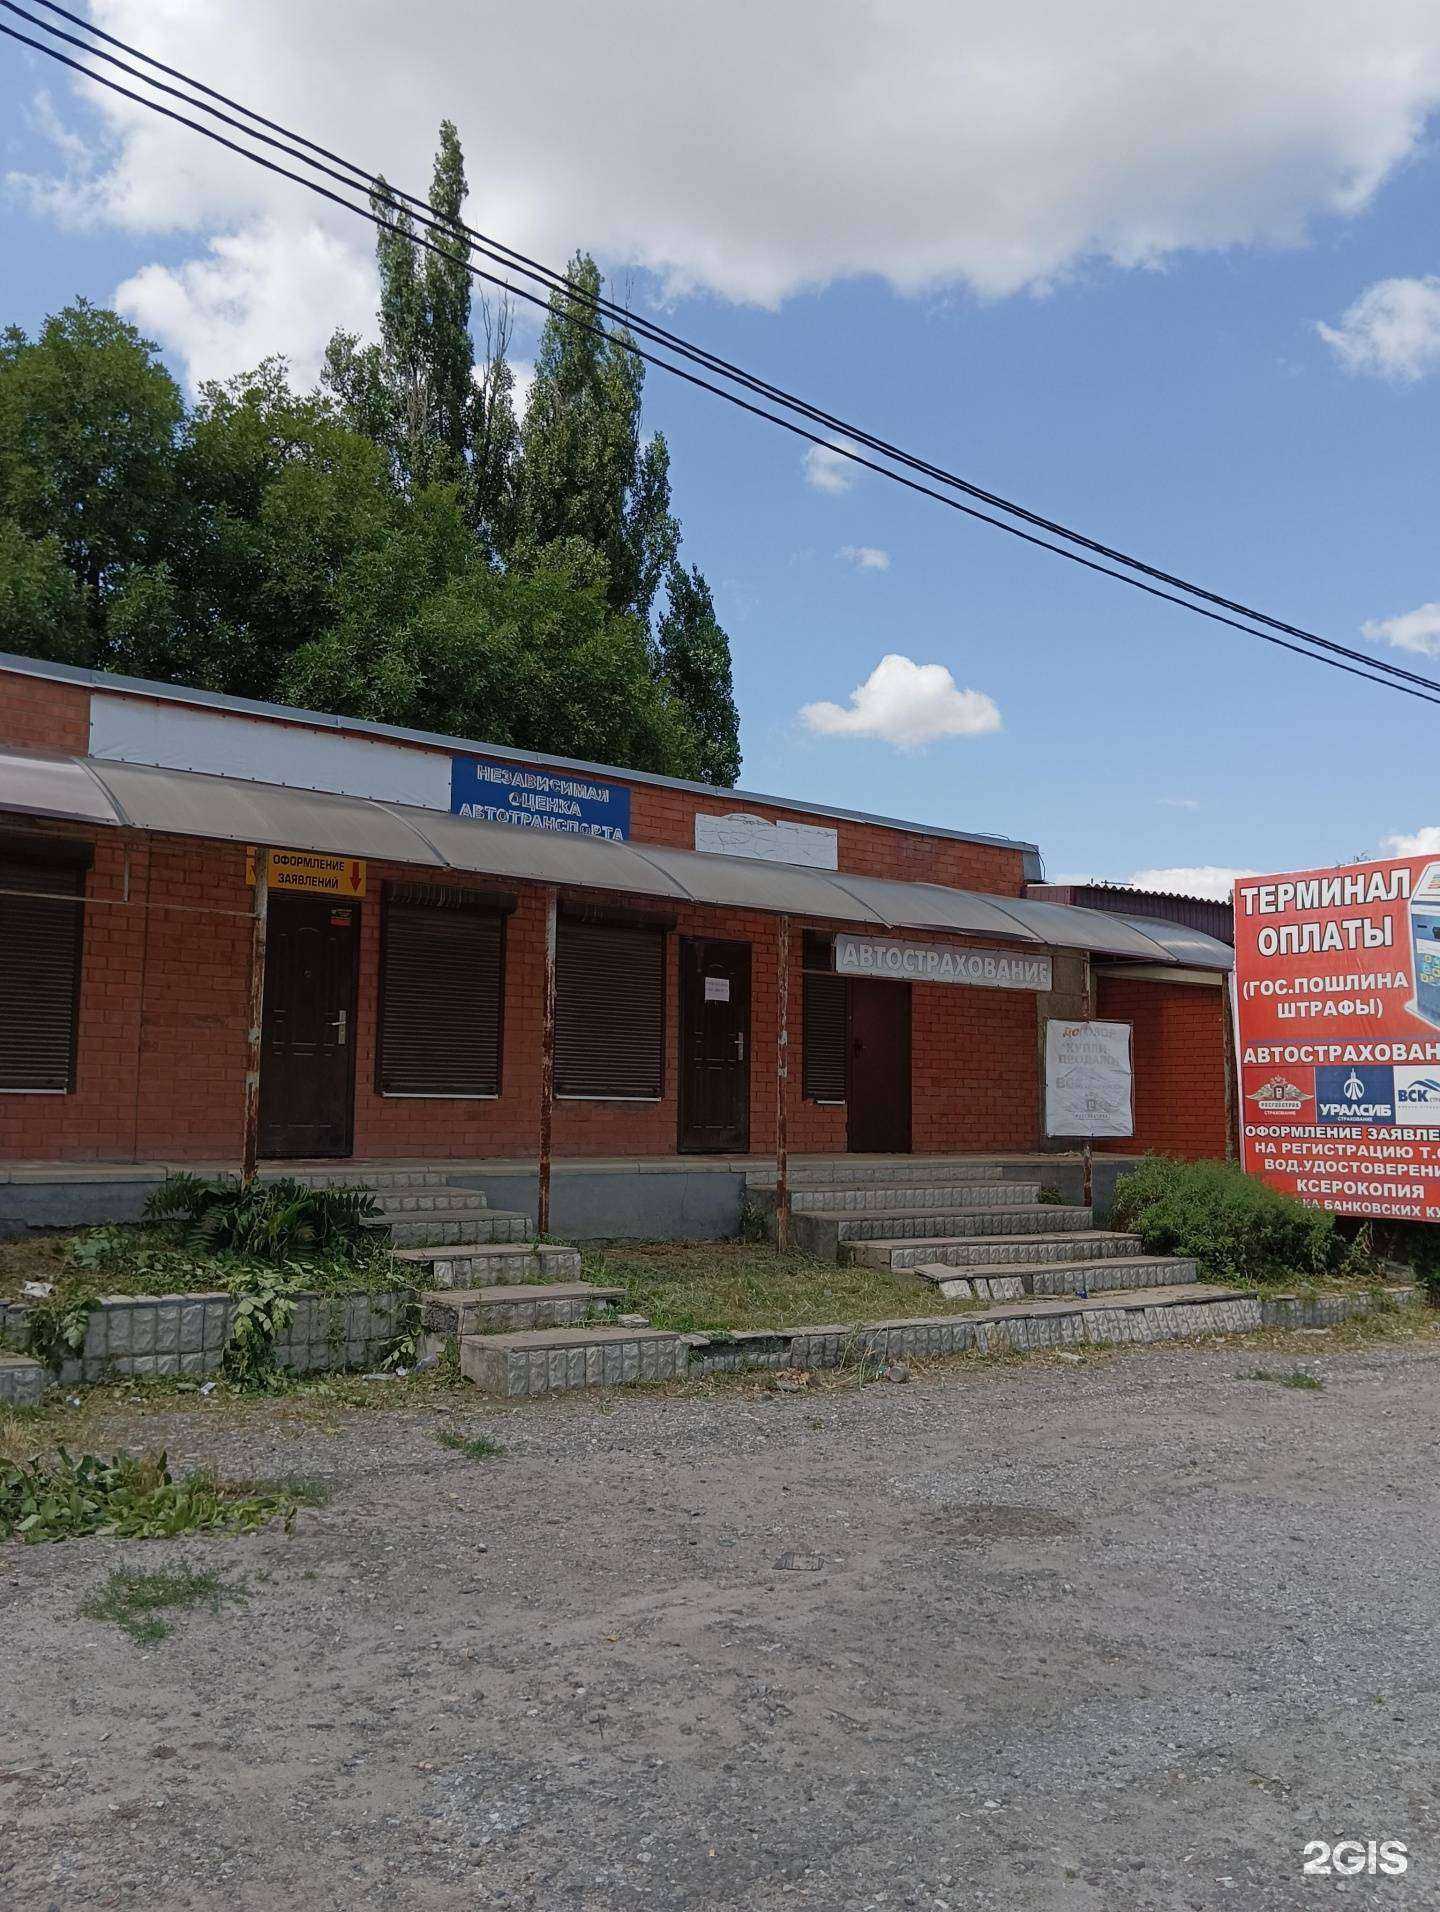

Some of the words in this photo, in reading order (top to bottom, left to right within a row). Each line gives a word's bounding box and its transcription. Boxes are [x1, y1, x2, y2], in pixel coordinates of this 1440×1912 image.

[477, 764, 610, 802] НЕЗАВИСИМАЯ
[508, 792, 582, 817] ОЦЕНКА
[459, 803, 624, 840] АВТОТРАНСПОРТА
[272, 854, 345, 872] ОФОРМЛЕНИЕ
[1240, 868, 1411, 916] ТЕРМИНАЛ
[1258, 916, 1393, 957] ОПЛАТЫ
[843, 942, 1048, 983] АВТОСТРАХОВАНИЕ
[1243, 971, 1408, 1000] (ГОС.ПОШЛИНА
[1277, 998, 1383, 1019] ШТРАФЫ)
[1243, 1043, 1440, 1064] АВТОСТРАХОВАН
[1398, 1089, 1429, 1103] ВСК
[1319, 1103, 1391, 1117] УРАЛСИБ
[1245, 1126, 1362, 1140] ОФОРМЛЕНИЕ
[1368, 1128, 1440, 1141] ЗАЯВЛЕ
[1255, 1142, 1277, 1154] НА
[1282, 1143, 1413, 1160] РЕГИСТРАЦИЮ
[1297, 1179, 1425, 1199] КСЕРОКОПИЯ
[1324, 1200, 1421, 1217] БАНКОВСКИХ
